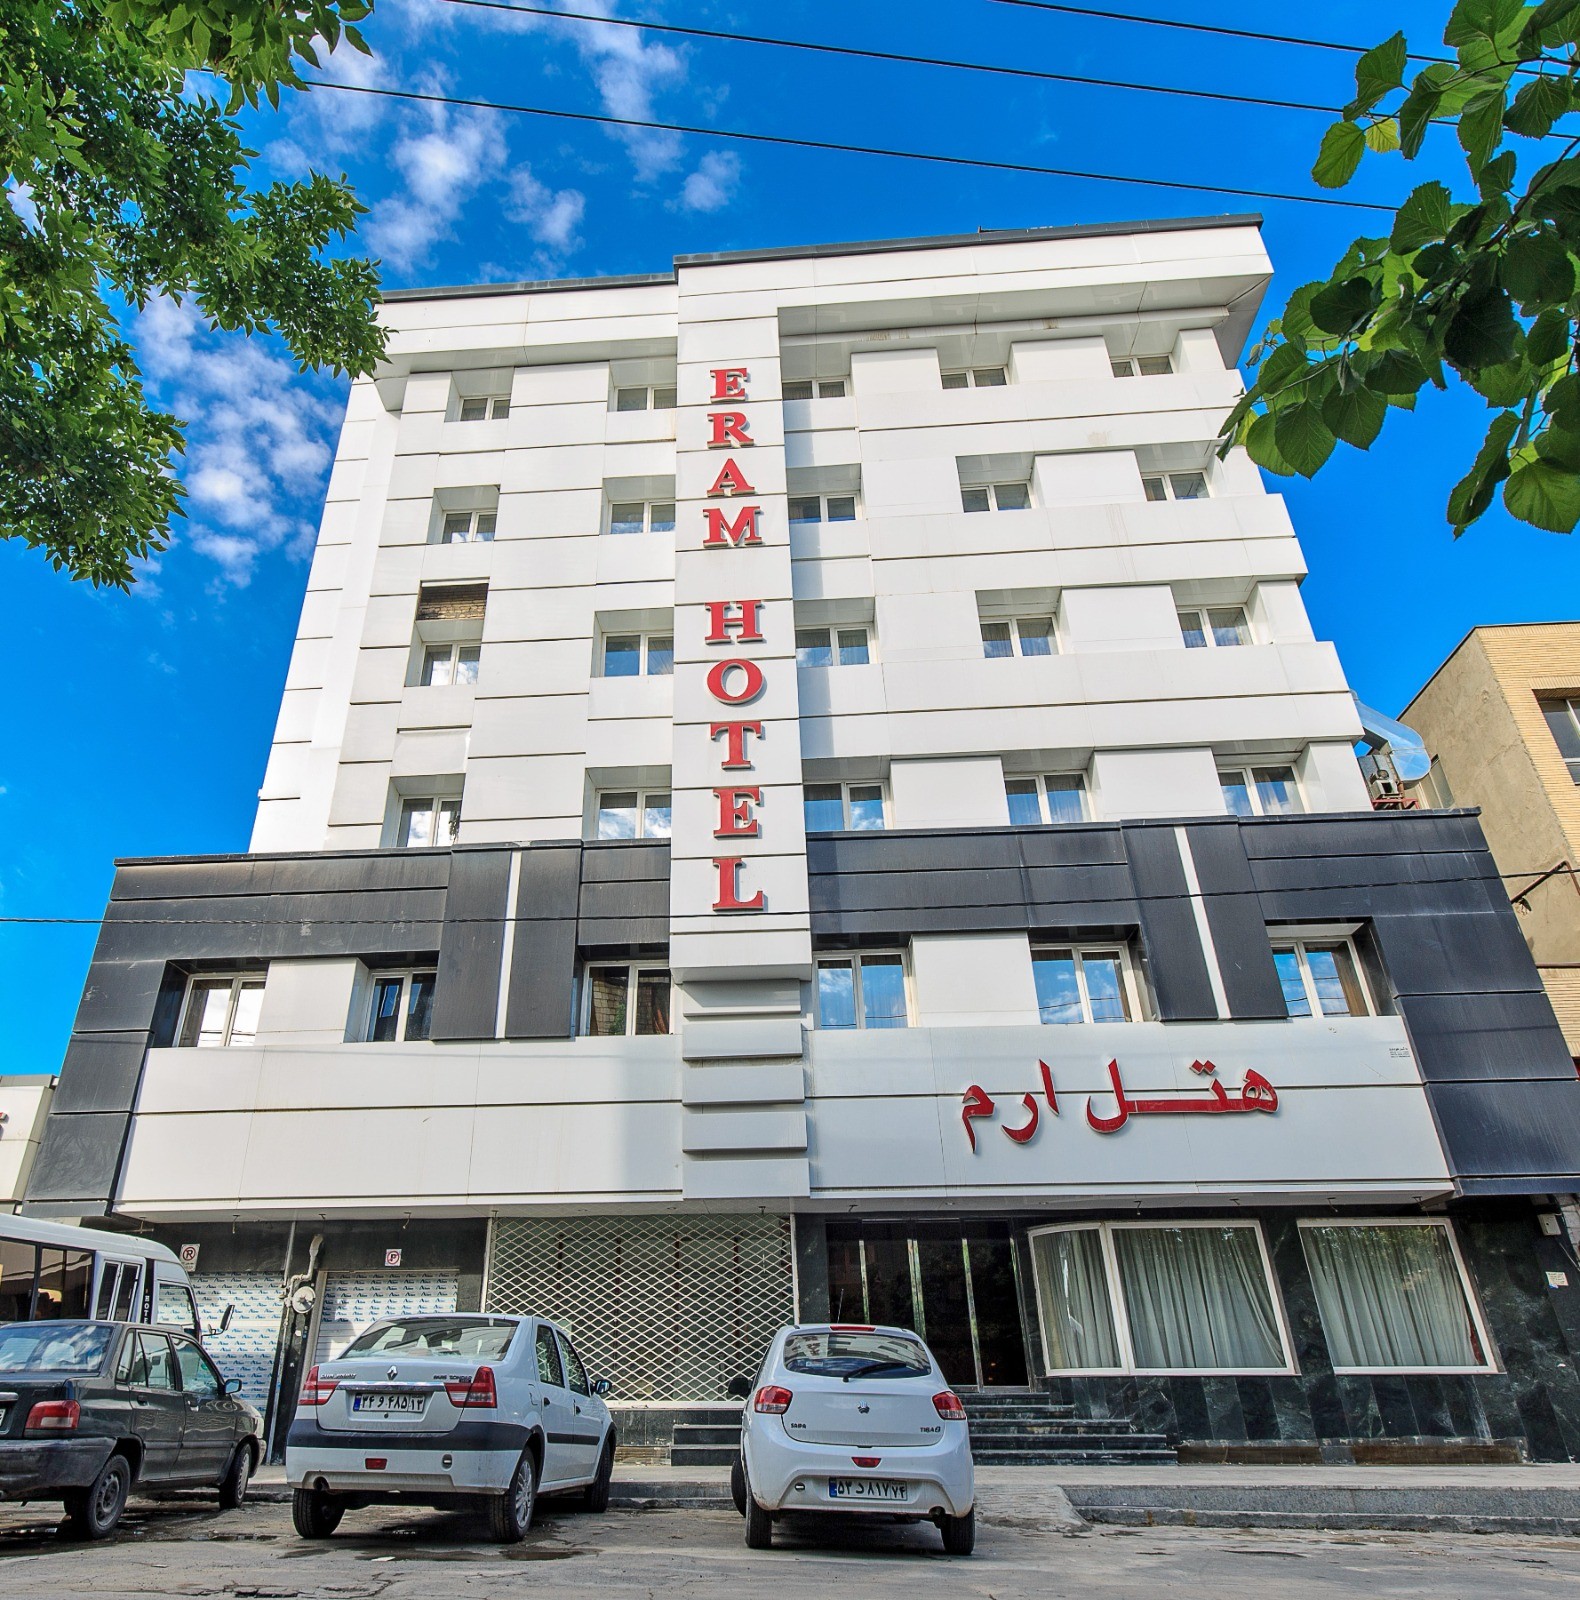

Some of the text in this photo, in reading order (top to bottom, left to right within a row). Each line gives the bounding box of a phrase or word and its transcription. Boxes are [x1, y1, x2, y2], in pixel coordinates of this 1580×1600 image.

[702, 367, 766, 914] ERAM HOTEL
[961, 1057, 1279, 1155] هتل ارم
